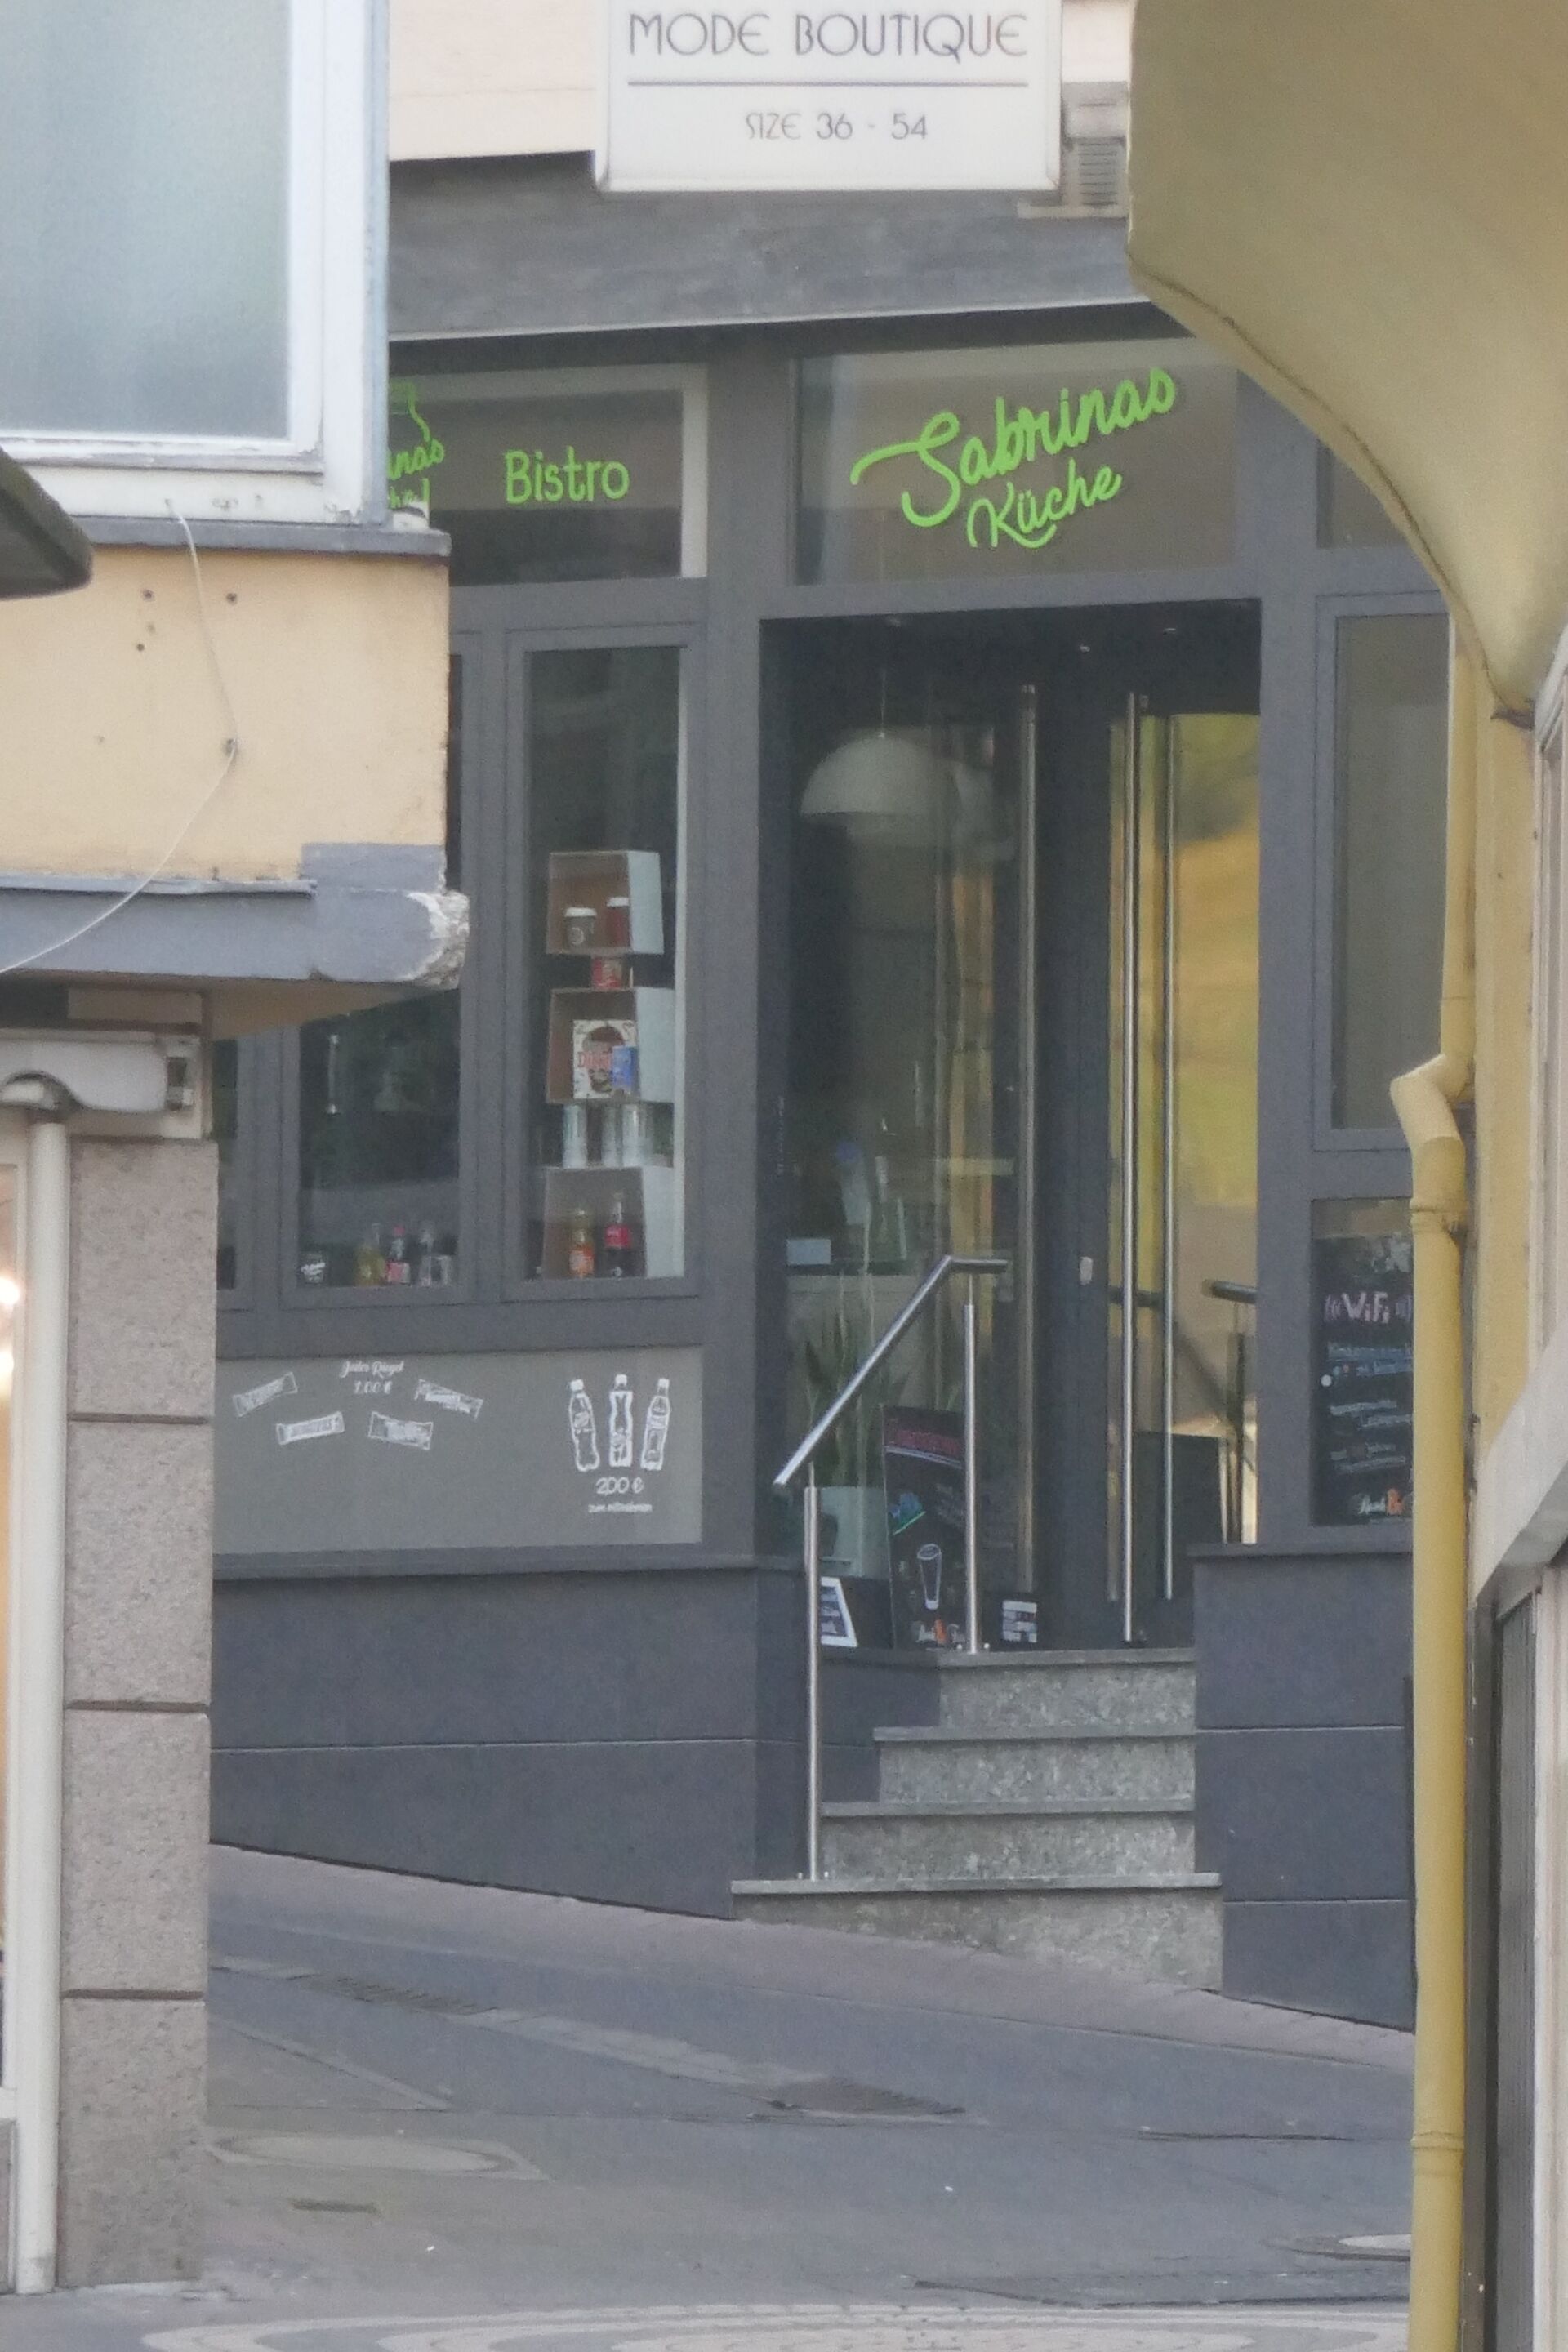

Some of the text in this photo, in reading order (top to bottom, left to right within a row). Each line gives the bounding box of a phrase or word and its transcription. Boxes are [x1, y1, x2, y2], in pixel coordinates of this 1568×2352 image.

[630, 13, 1028, 63] MODE BOUTIQUE
[746, 112, 802, 140] SIZE
[817, 112, 853, 140] 36
[892, 112, 929, 140] 54
[503, 446, 630, 505] Bistro
[849, 367, 1176, 528] Sabrinas
[967, 457, 1123, 548] Küche
